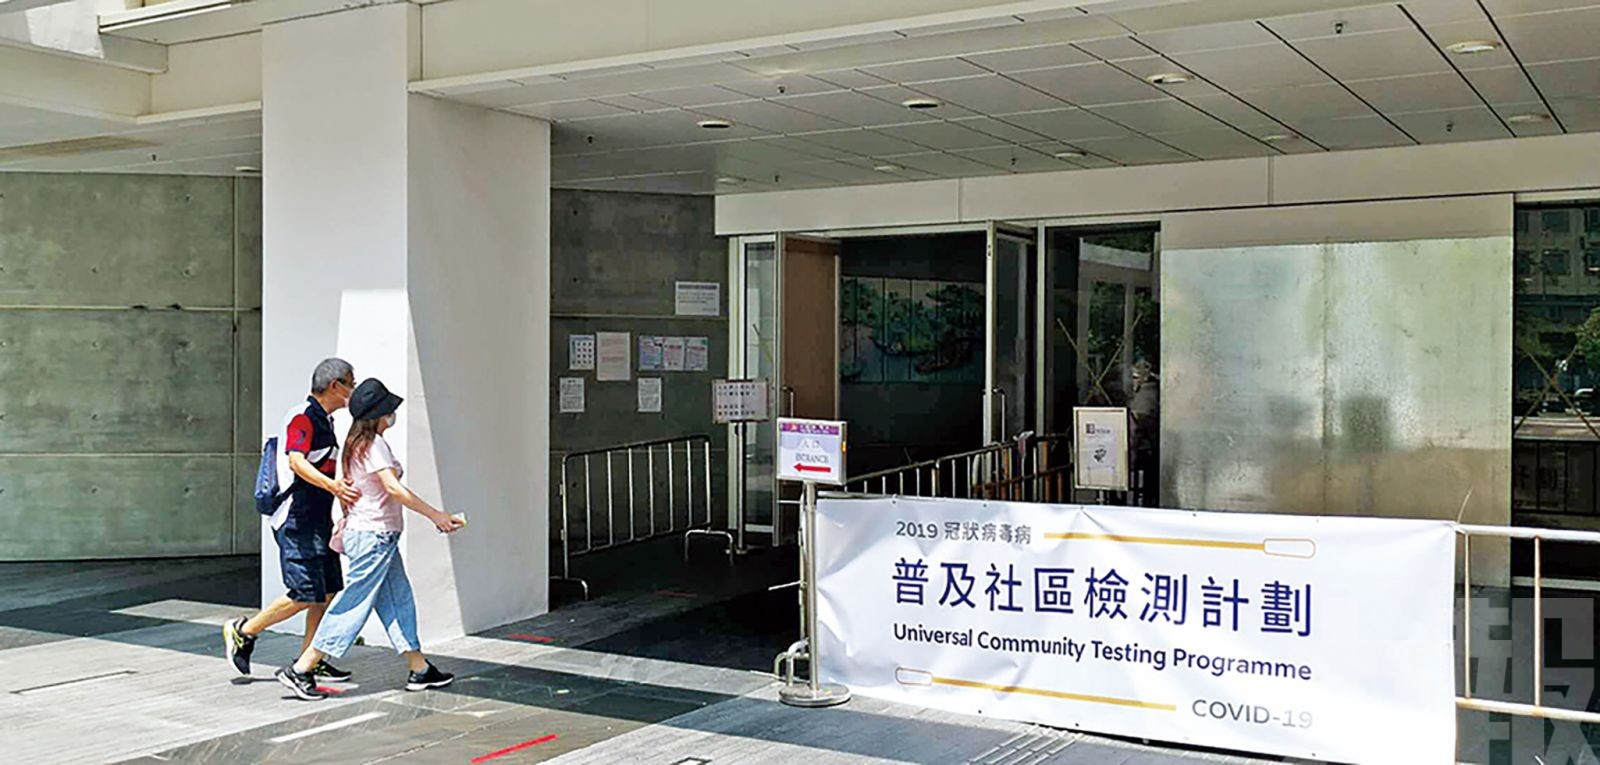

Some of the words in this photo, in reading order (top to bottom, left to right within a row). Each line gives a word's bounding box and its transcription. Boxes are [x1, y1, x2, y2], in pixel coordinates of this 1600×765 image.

[896, 521, 938, 539] 2019
[944, 522, 1031, 544] 冠狀病毒病
[892, 557, 1311, 637] 普及社區檢測計劃
[893, 622, 973, 648] Universal
[977, 631, 1086, 662] Community
[1091, 640, 1166, 671] Testing
[1173, 648, 1312, 681] Programme
[1192, 699, 1313, 729] COVID-19
